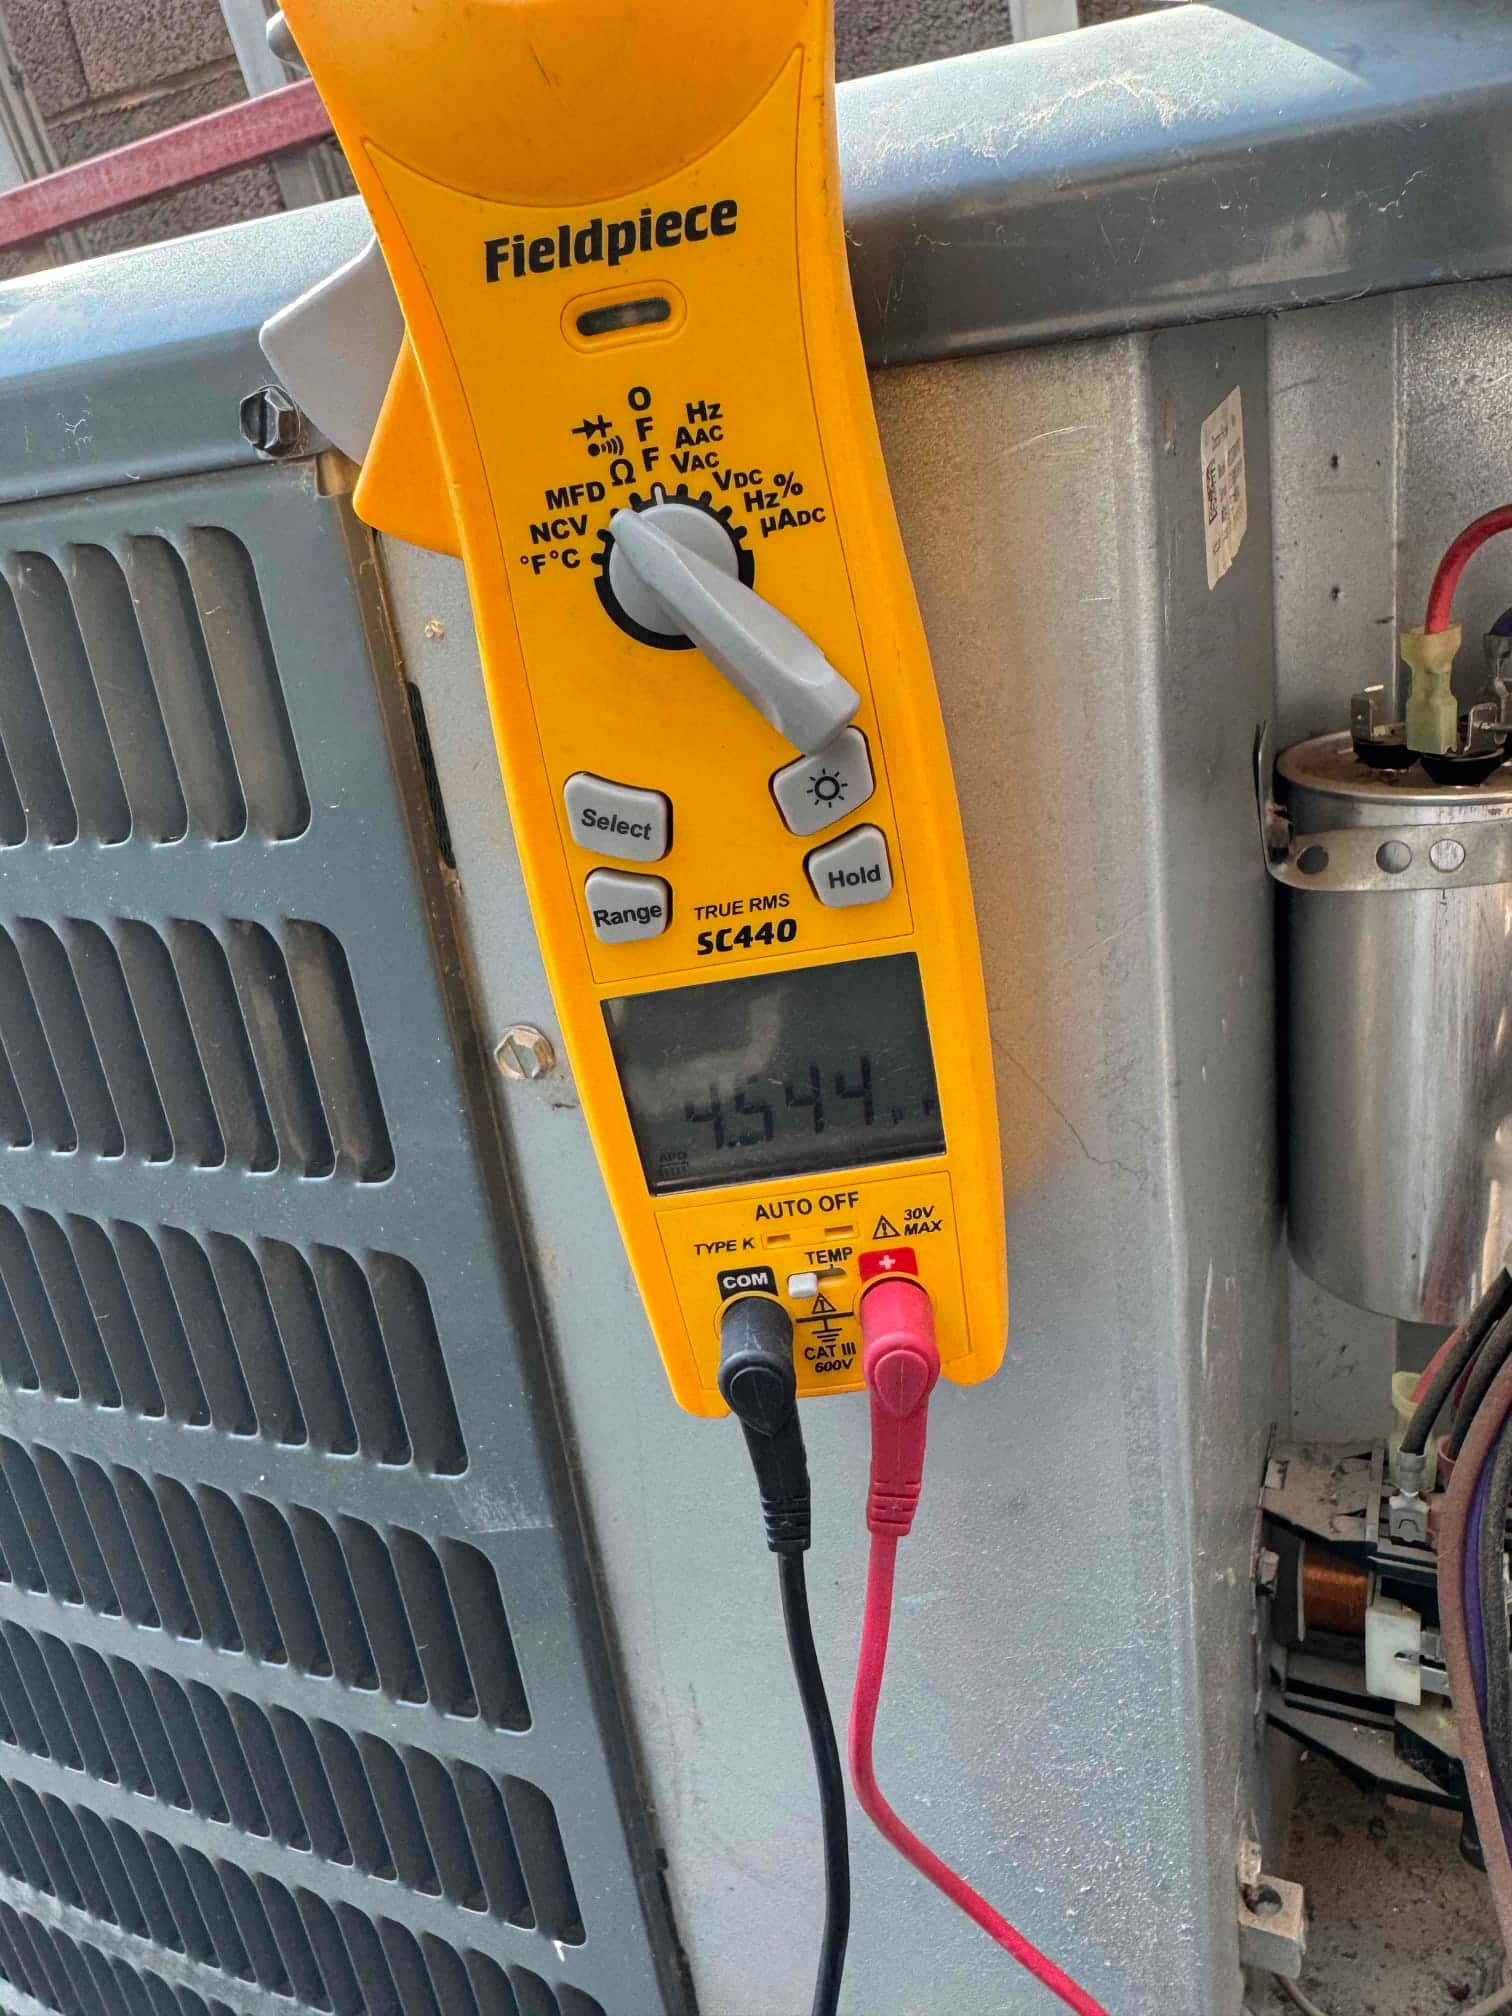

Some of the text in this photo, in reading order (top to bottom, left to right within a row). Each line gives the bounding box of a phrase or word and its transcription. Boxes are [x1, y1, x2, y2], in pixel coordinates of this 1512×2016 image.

[484, 199, 737, 283] Fieldpiece
[686, 400, 723, 424] Hz
[545, 480, 606, 511] MFD
[529, 515, 588, 544] NCV
[581, 808, 652, 841] Select
[828, 864, 882, 890] Hold
[593, 903, 662, 928] Range
[694, 893, 790, 921] TRUE RMS
[696, 918, 797, 956] SC440
[755, 1191, 860, 1221] AUTO OFF
[904, 1206, 935, 1221] 30V
[903, 1219, 943, 1237] MAX
[694, 1237, 755, 1256] TYPE K
[805, 1247, 853, 1265] TEMP
[722, 1272, 769, 1289] COM
[804, 1344, 838, 1361] CAT
[815, 1359, 854, 1373] 600V
